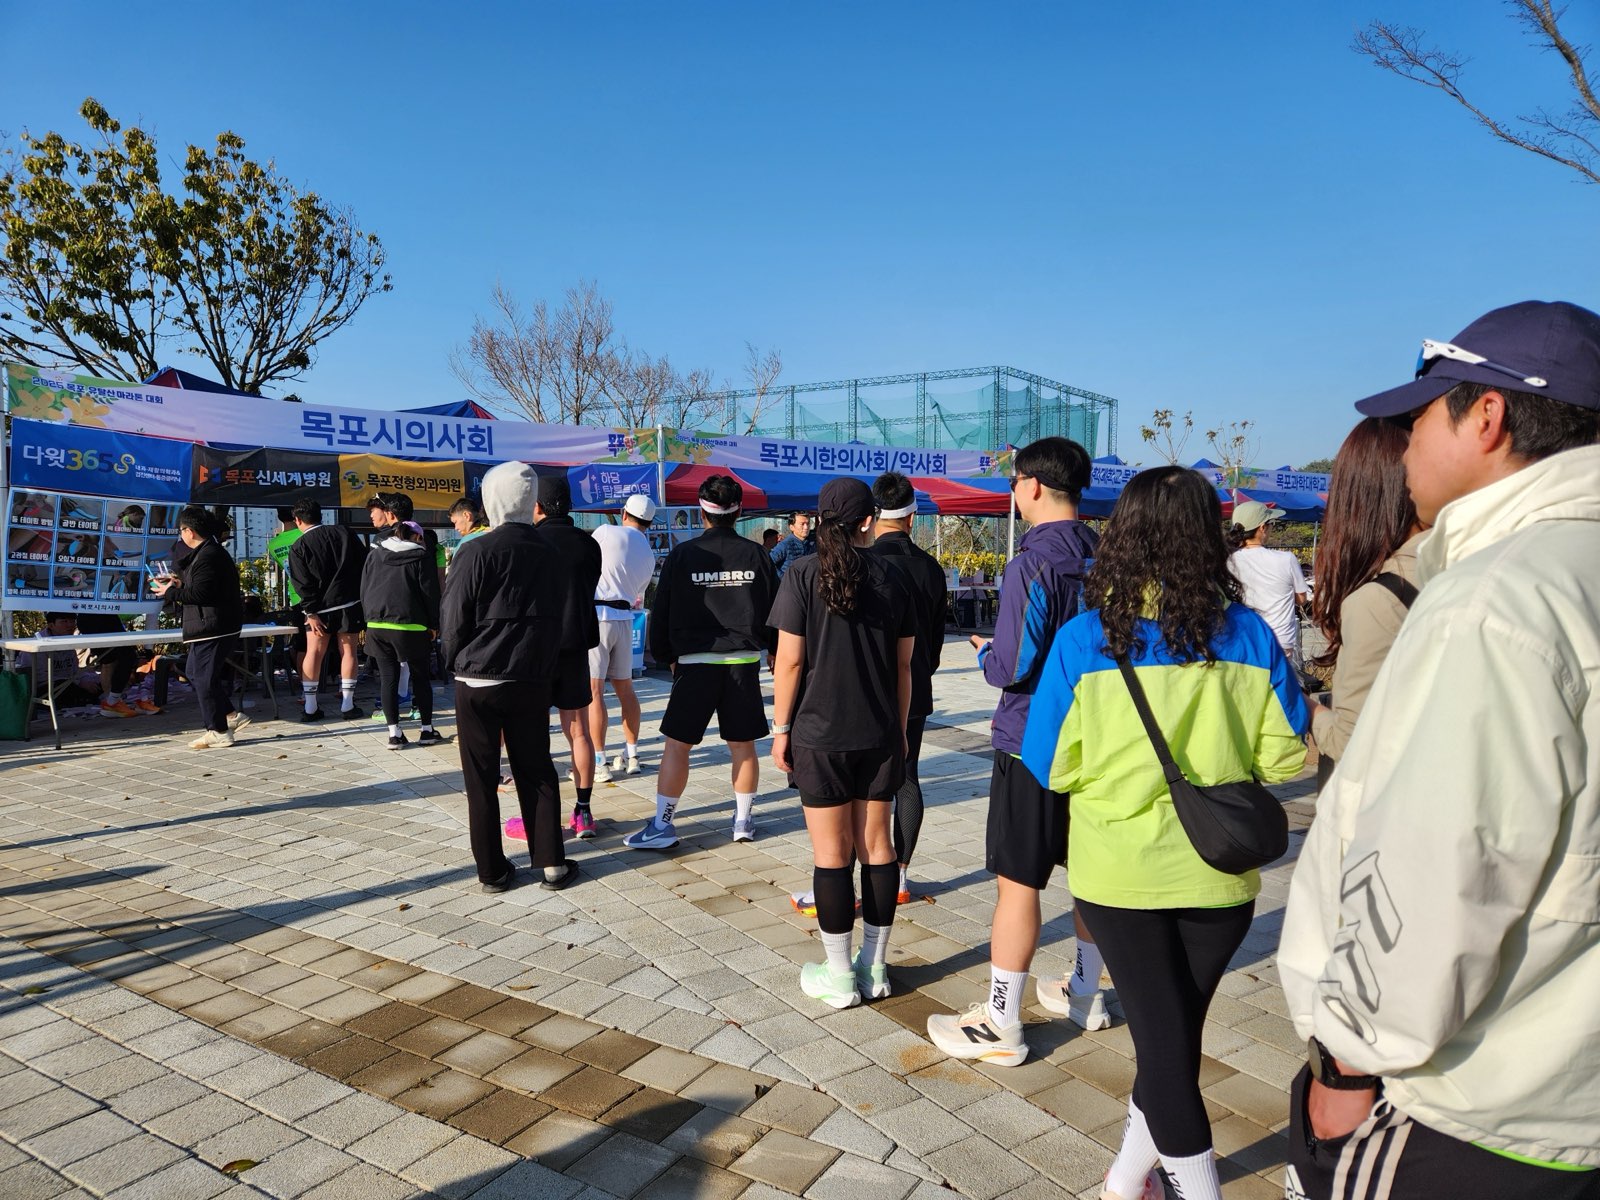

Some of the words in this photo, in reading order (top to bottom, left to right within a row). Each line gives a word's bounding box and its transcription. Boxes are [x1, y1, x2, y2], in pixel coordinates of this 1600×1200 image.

[32, 376, 64, 389] 2025
[66, 383, 86, 394] 목포
[145, 394, 164, 404] 대회
[300, 410, 494, 455] 목포시의사회
[759, 442, 947, 475] 목포시한의사회/약사회
[225, 469, 331, 487] 목포신세계병원
[367, 473, 461, 492] 목포정형외과의원
[600, 471, 620, 484] 하당
[1276, 473, 1327, 491] 목포과학대학교
[691, 570, 755, 582] UMBRO
